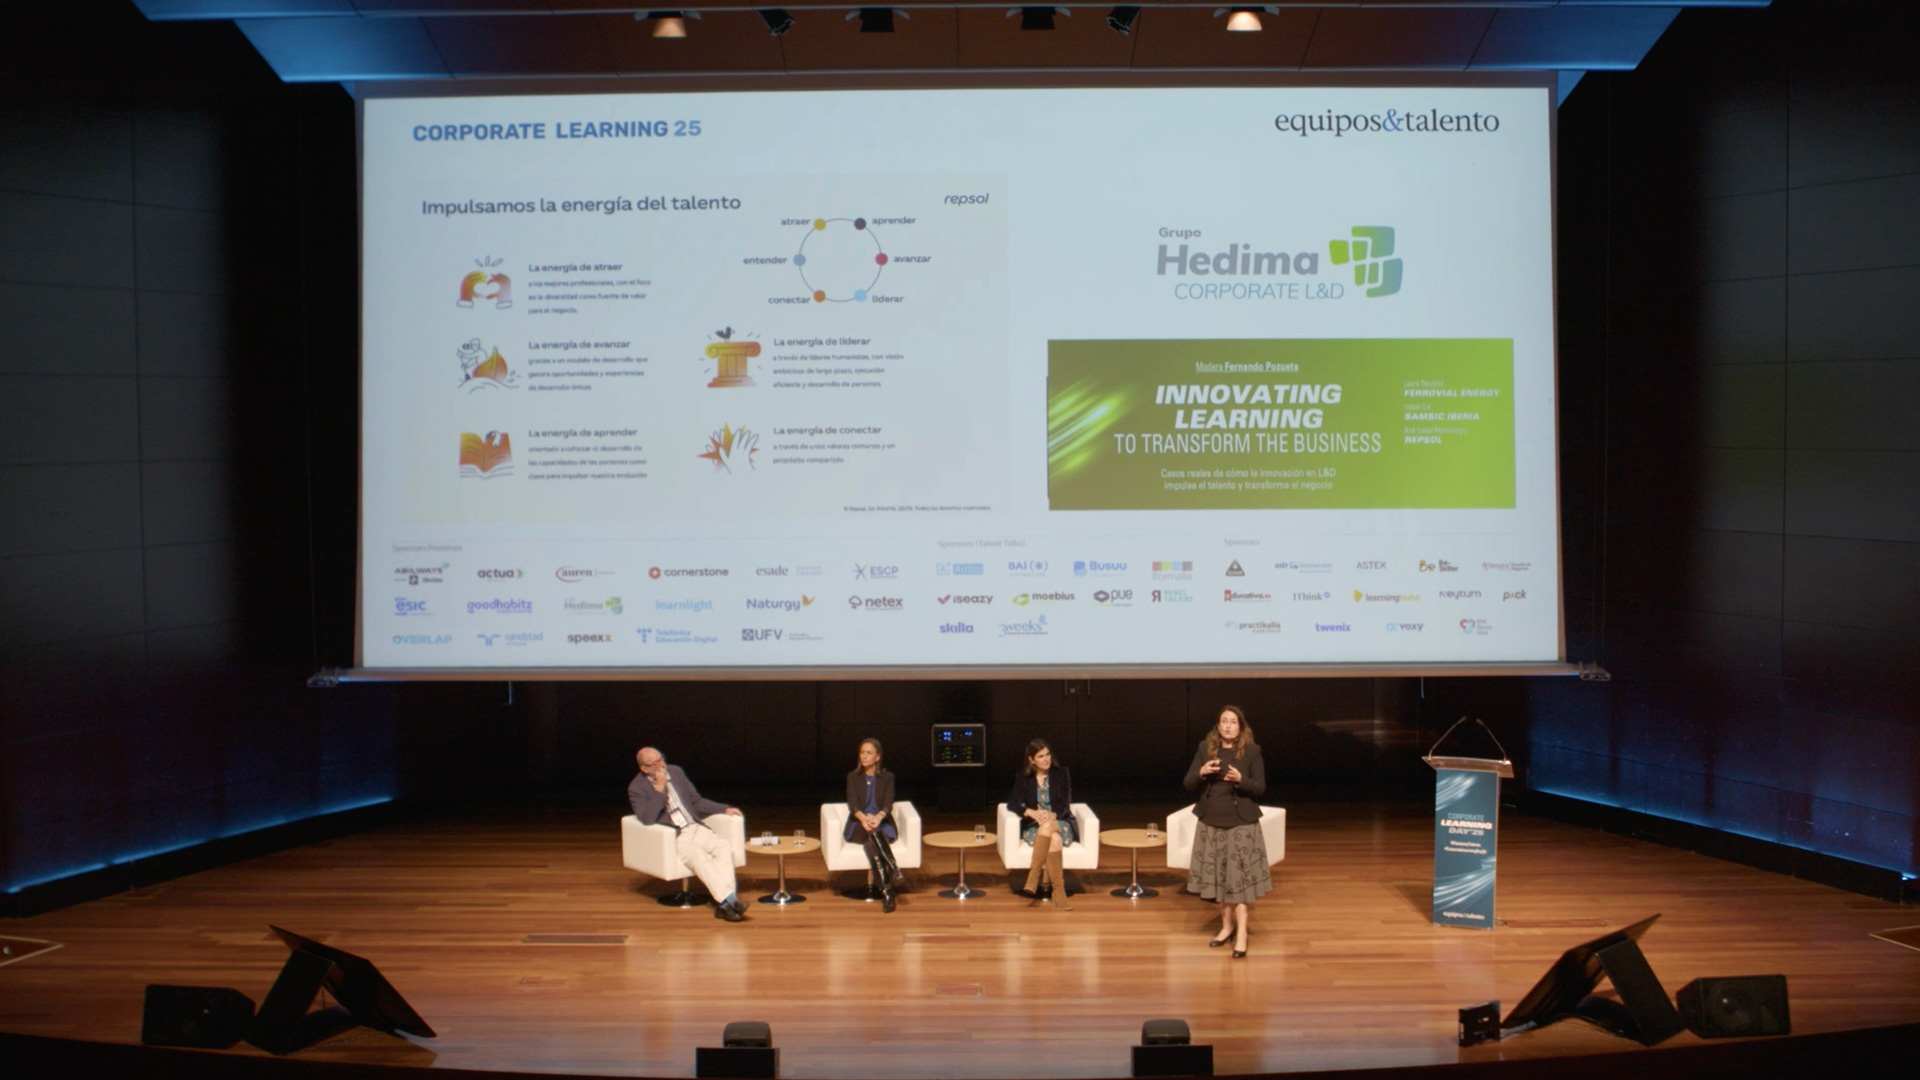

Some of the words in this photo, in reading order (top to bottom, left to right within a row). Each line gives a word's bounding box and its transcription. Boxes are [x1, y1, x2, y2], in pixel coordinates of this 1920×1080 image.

[1275, 108, 1500, 137] equipos&talento
[413, 123, 545, 141] CORPORATE
[556, 121, 668, 138] LEARNING
[673, 120, 701, 137] 25
[944, 194, 989, 206] repsol
[422, 199, 535, 217] Impulsamos
[540, 198, 557, 213] la
[562, 196, 632, 214] energía
[637, 196, 667, 211] del
[672, 195, 741, 210] talento
[781, 218, 811, 226] atraer
[872, 216, 916, 226] aprender
[1158, 227, 1201, 240] Grupo
[743, 256, 787, 265] entender
[894, 255, 931, 263] avanzar
[1156, 243, 1319, 276] Hedima
[528, 264, 539, 272] La
[542, 263, 577, 273] energía
[594, 263, 623, 271] atraer
[1174, 283, 1299, 300] CORPORATE
[1305, 282, 1344, 299] L&D
[768, 296, 811, 304] conectar
[872, 295, 904, 303] liderar
[542, 341, 577, 350] energía
[580, 341, 591, 349] de
[594, 341, 631, 349] avanzar
[787, 338, 823, 347] energía
[826, 338, 837, 346] de
[1196, 362, 1223, 371] Modera
[1225, 362, 1263, 371] Fernando
[1266, 362, 1299, 371] Pozueta
[1155, 384, 1342, 404] INNOVATING
[1404, 389, 1457, 397] FERROVIAL
[1460, 389, 1500, 397] ENERGY
[1175, 409, 1323, 429] LEARNING
[1404, 412, 1444, 420] SAMSIC
[1447, 412, 1479, 420] IBERIA
[528, 430, 539, 438] La
[542, 429, 577, 439] energía
[580, 429, 591, 437] de
[594, 428, 638, 438] aprender
[773, 427, 785, 435] La
[787, 426, 823, 436] energía
[825, 426, 837, 434] de
[839, 426, 881, 435] conectar
[1115, 433, 1136, 454] TO
[1142, 433, 1250, 454] TRANSFORM
[1256, 433, 1288, 453] THE
[1294, 432, 1381, 453] BUSINESS
[1405, 436, 1442, 444] REPSOL
[1161, 469, 1185, 479] Casos
[1187, 468, 1211, 478] reales
[1214, 468, 1223, 478] de
[1226, 468, 1248, 478] cómo
[1251, 468, 1258, 478] la
[1260, 468, 1304, 478] innovación
[1306, 470, 1316, 478] en
[1318, 468, 1336, 478] L&D
[1164, 481, 1197, 492] impulsa
[1199, 481, 1206, 489] el
[1208, 481, 1236, 489] talento
[1238, 483, 1243, 492] y
[1245, 480, 1289, 489] transforma
[1292, 480, 1299, 489] el
[1301, 480, 1332, 491] negocio
[1090, 561, 1127, 571] Busuu
[1357, 561, 1386, 569] ASTEX
[478, 569, 514, 579] actua
[561, 569, 592, 578] auren
[664, 568, 729, 577] cornerstone
[756, 565, 789, 576] esade
[870, 566, 898, 576] ESCP
[953, 594, 993, 605] iseazy
[1032, 591, 1075, 601] moebius
[1111, 590, 1133, 602] pue
[564, 601, 603, 610] Hedima
[656, 600, 713, 612] learnlight
[746, 598, 801, 611] Naturgy
[865, 596, 903, 608] netex
[939, 622, 974, 633] skilla
[1315, 623, 1351, 632] twenix
[393, 635, 452, 644] OVERLAP
[505, 632, 543, 641] randstad
[567, 633, 612, 644] speexx
[694, 636, 717, 644] Digital
[754, 629, 783, 641] UFV
[1448, 812, 1485, 821] CORPORATE
[1440, 819, 1493, 830] LEARNING
